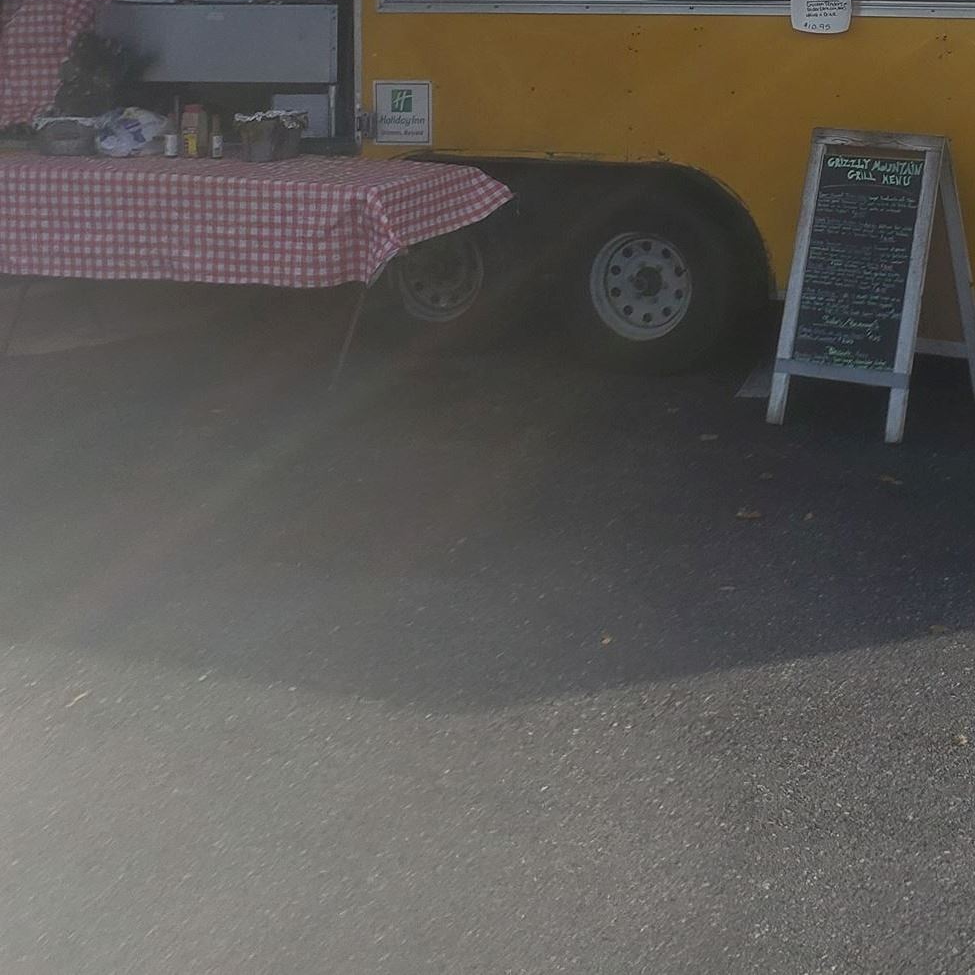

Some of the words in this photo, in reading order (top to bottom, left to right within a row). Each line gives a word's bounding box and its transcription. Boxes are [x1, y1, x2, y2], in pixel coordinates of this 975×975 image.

[378, 115, 411, 127] Holiday
[411, 115, 425, 125] Inn
[827, 155, 871, 170] GRIZZLY
[871, 160, 923, 176] MOUNTAIN
[847, 169, 877, 182] GRILL
[882, 173, 912, 187] MENU
